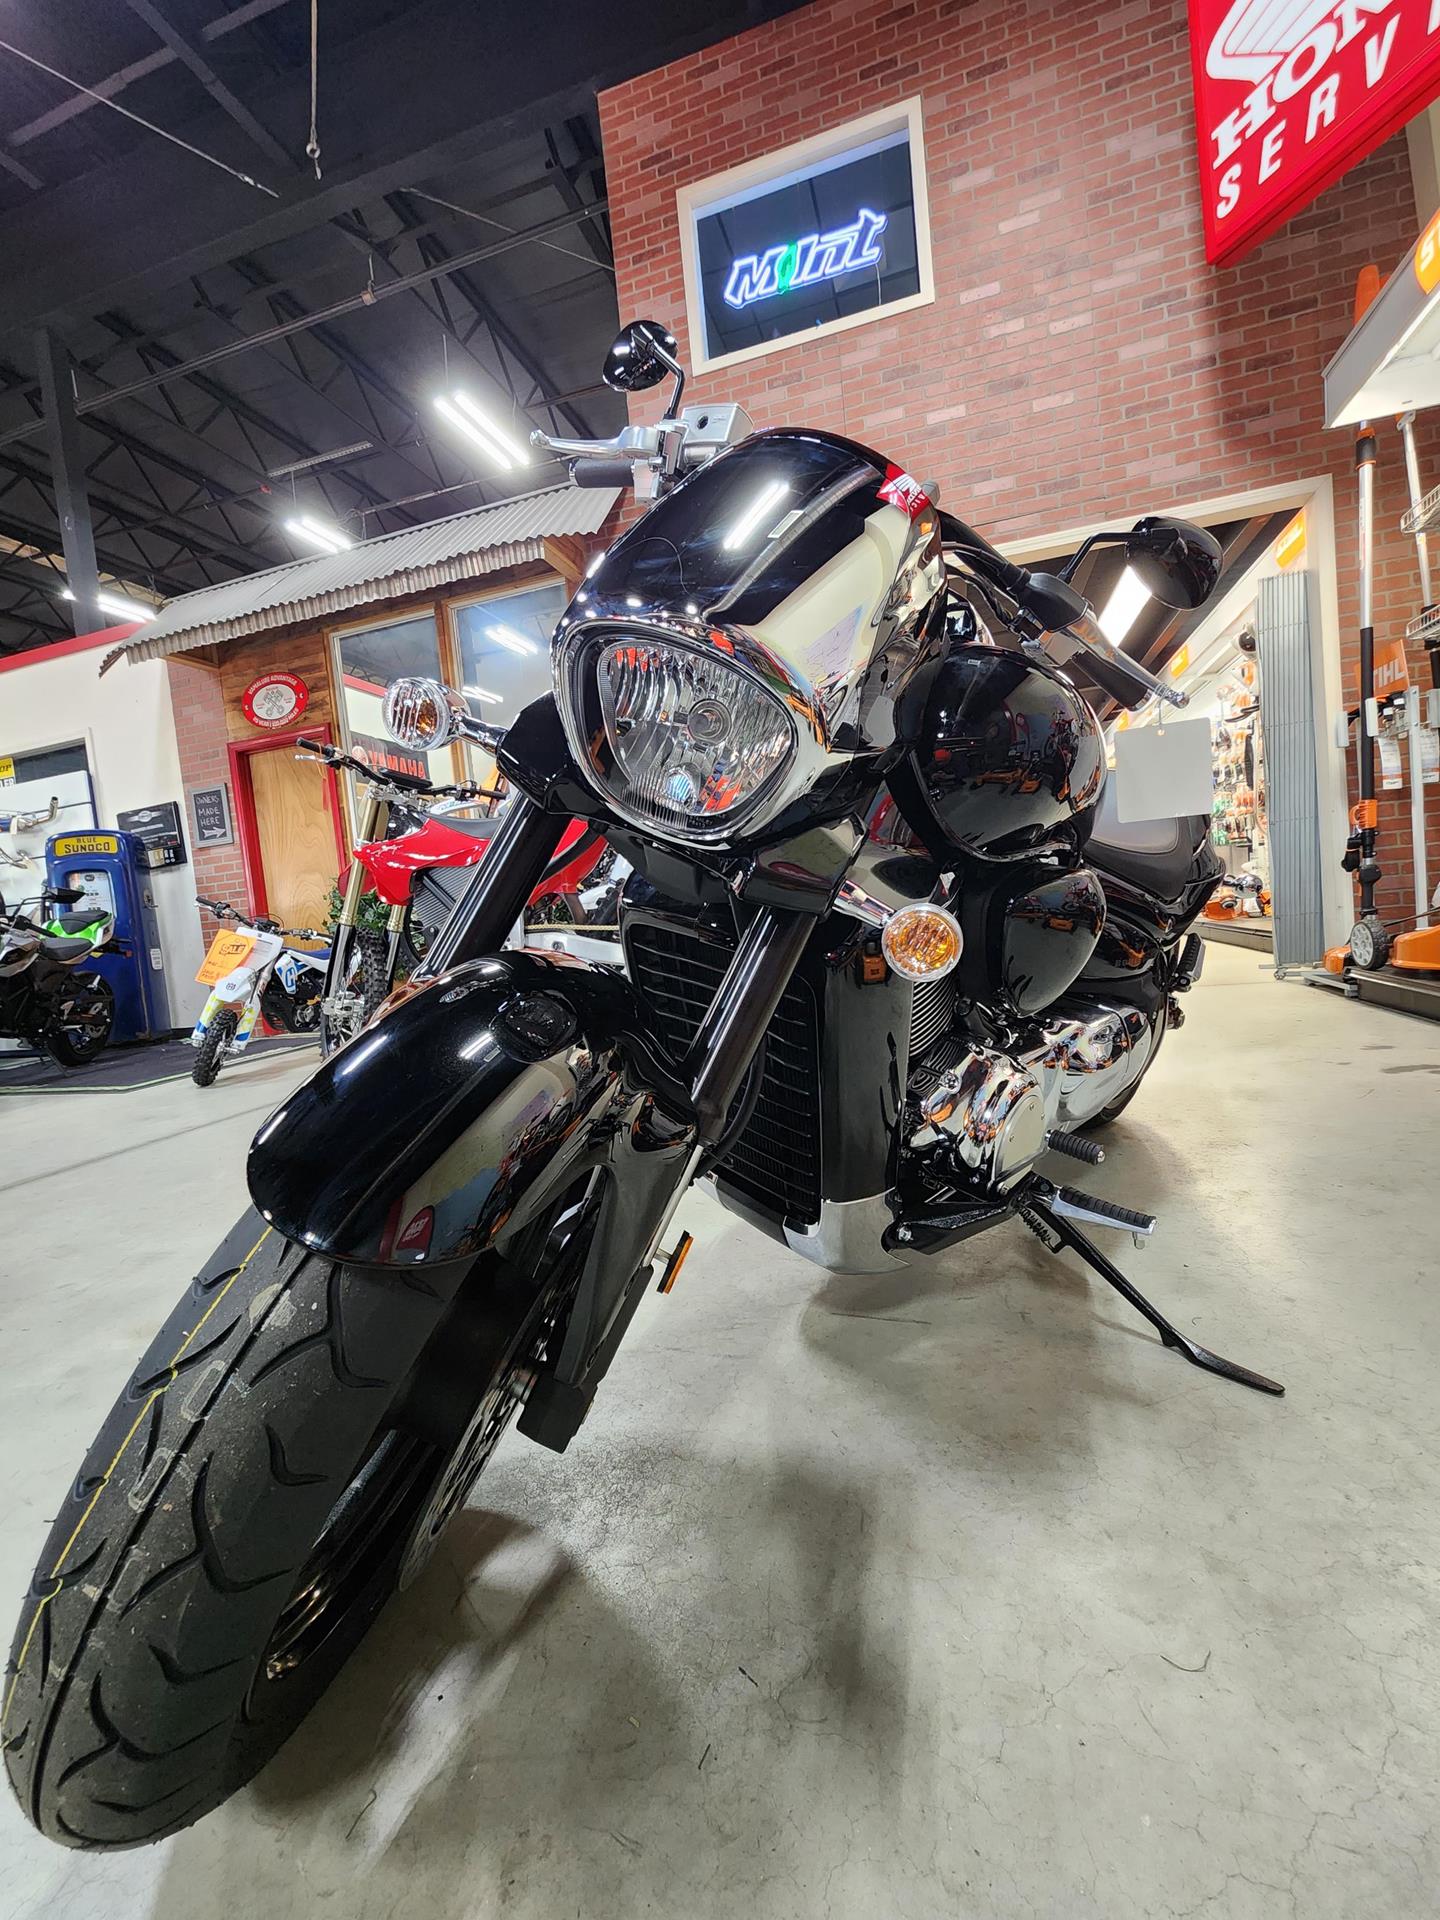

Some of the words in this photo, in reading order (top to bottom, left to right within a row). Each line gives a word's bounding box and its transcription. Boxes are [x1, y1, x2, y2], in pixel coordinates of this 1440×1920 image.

[368, 750, 426, 779] YAMAHA
[198, 806, 221, 817] MADE
[201, 816, 220, 827] HERE
[64, 842, 110, 854] SUNOCO
[221, 944, 246, 955] SALE
